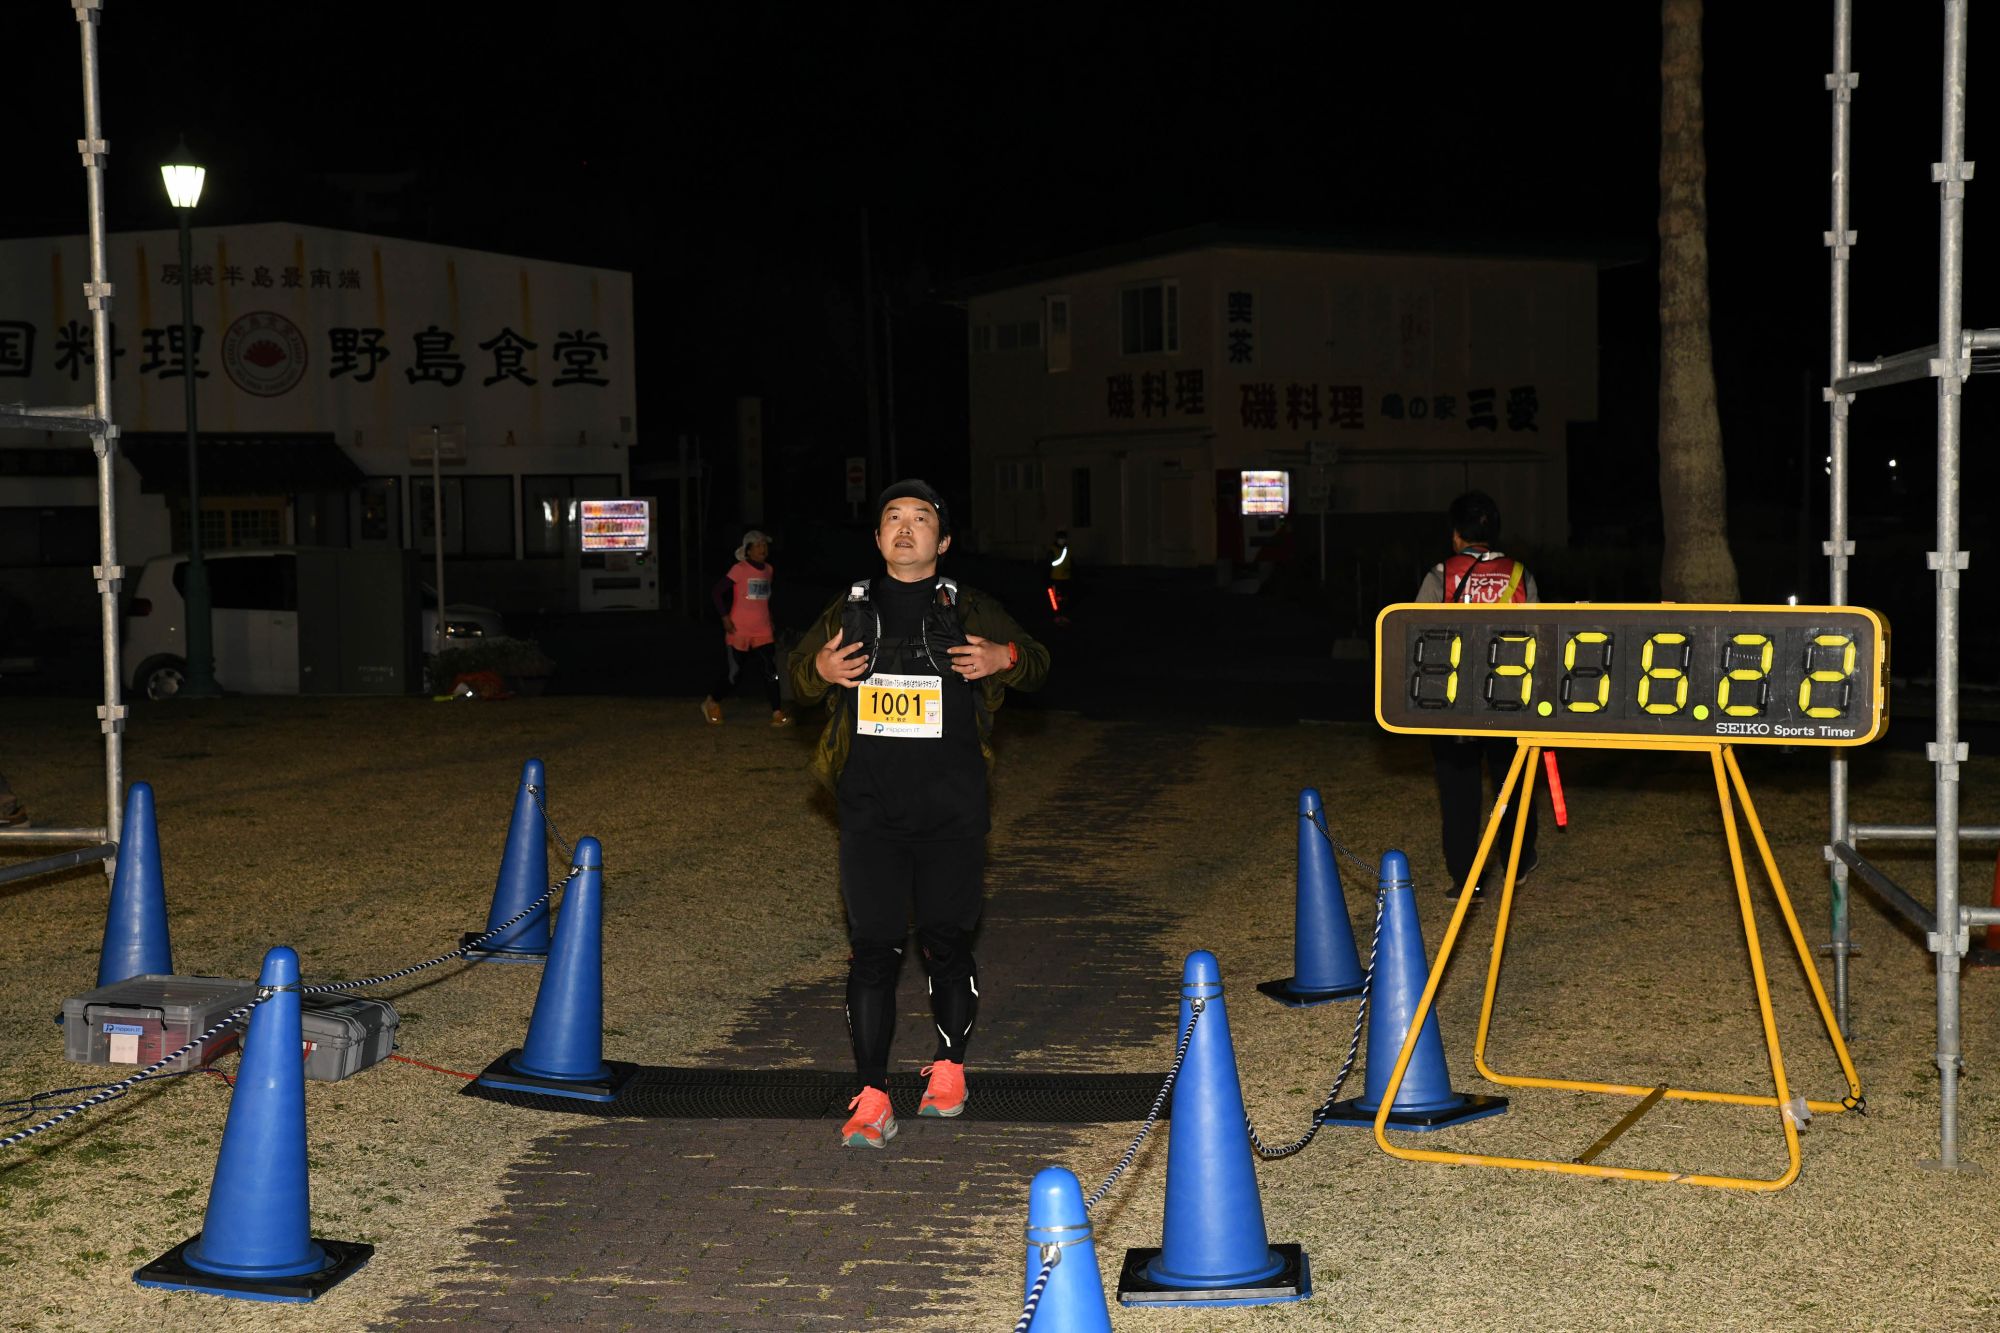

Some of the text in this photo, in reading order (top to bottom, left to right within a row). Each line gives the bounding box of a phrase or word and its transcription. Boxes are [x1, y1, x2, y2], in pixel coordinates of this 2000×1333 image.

[329, 325, 609, 387] 野島食堂
[1106, 369, 1205, 419] 磯料理
[1239, 382, 1364, 431] 磯料理
[1466, 385, 1539, 433] 三愛
[872, 692, 920, 717] 1001
[1716, 722, 1856, 737] SEIKO Sports Timer
